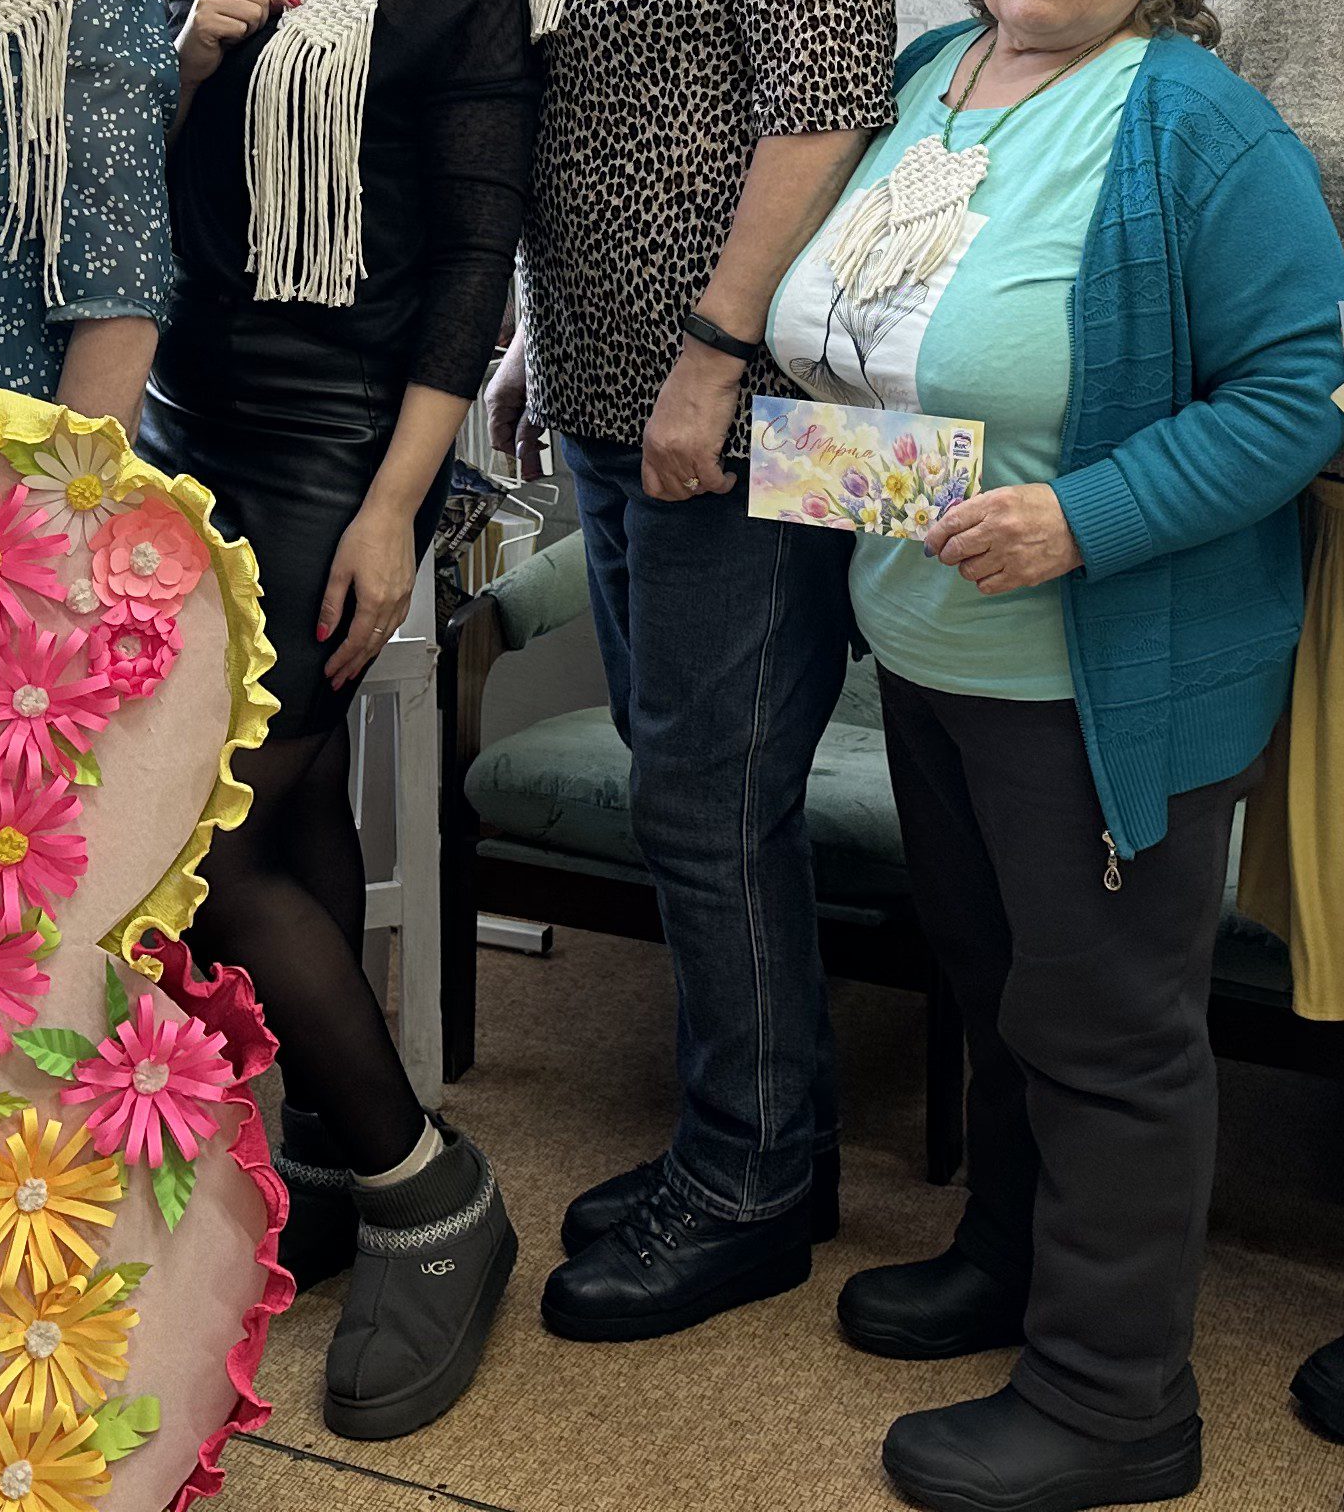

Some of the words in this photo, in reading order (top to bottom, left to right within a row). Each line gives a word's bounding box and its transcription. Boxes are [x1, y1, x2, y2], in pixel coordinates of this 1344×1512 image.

[761, 414, 789, 451] С
[796, 424, 818, 450] 8
[420, 1258, 455, 1275] UGG
